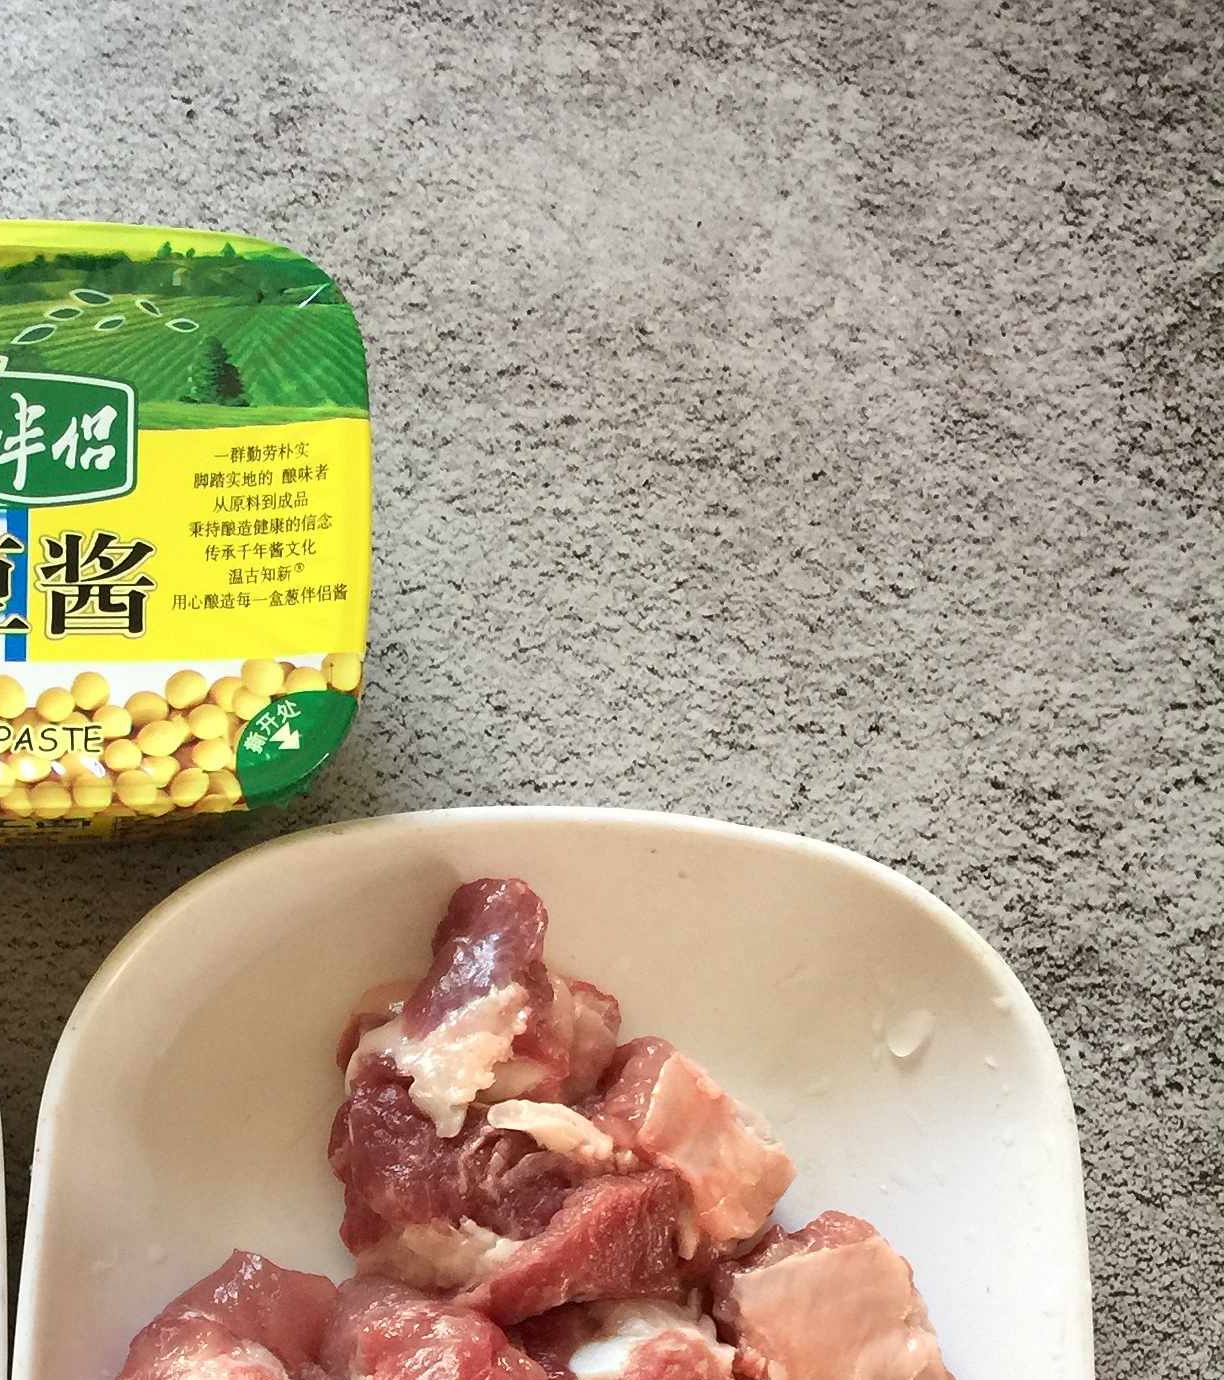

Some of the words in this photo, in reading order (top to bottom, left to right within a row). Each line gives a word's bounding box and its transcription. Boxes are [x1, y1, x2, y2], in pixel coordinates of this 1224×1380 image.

[214, 441, 310, 464] 一群勤劳朴实
[193, 470, 273, 489] 脚踏实地的
[281, 463, 329, 485] 酿味者
[213, 490, 309, 513] 从原料到成品
[189, 512, 333, 539] 秉持酿造健康的信念
[204, 538, 317, 562] 传承千年酱文化
[171, 583, 349, 611] 用心酿造每一盒葱伴侣酱
